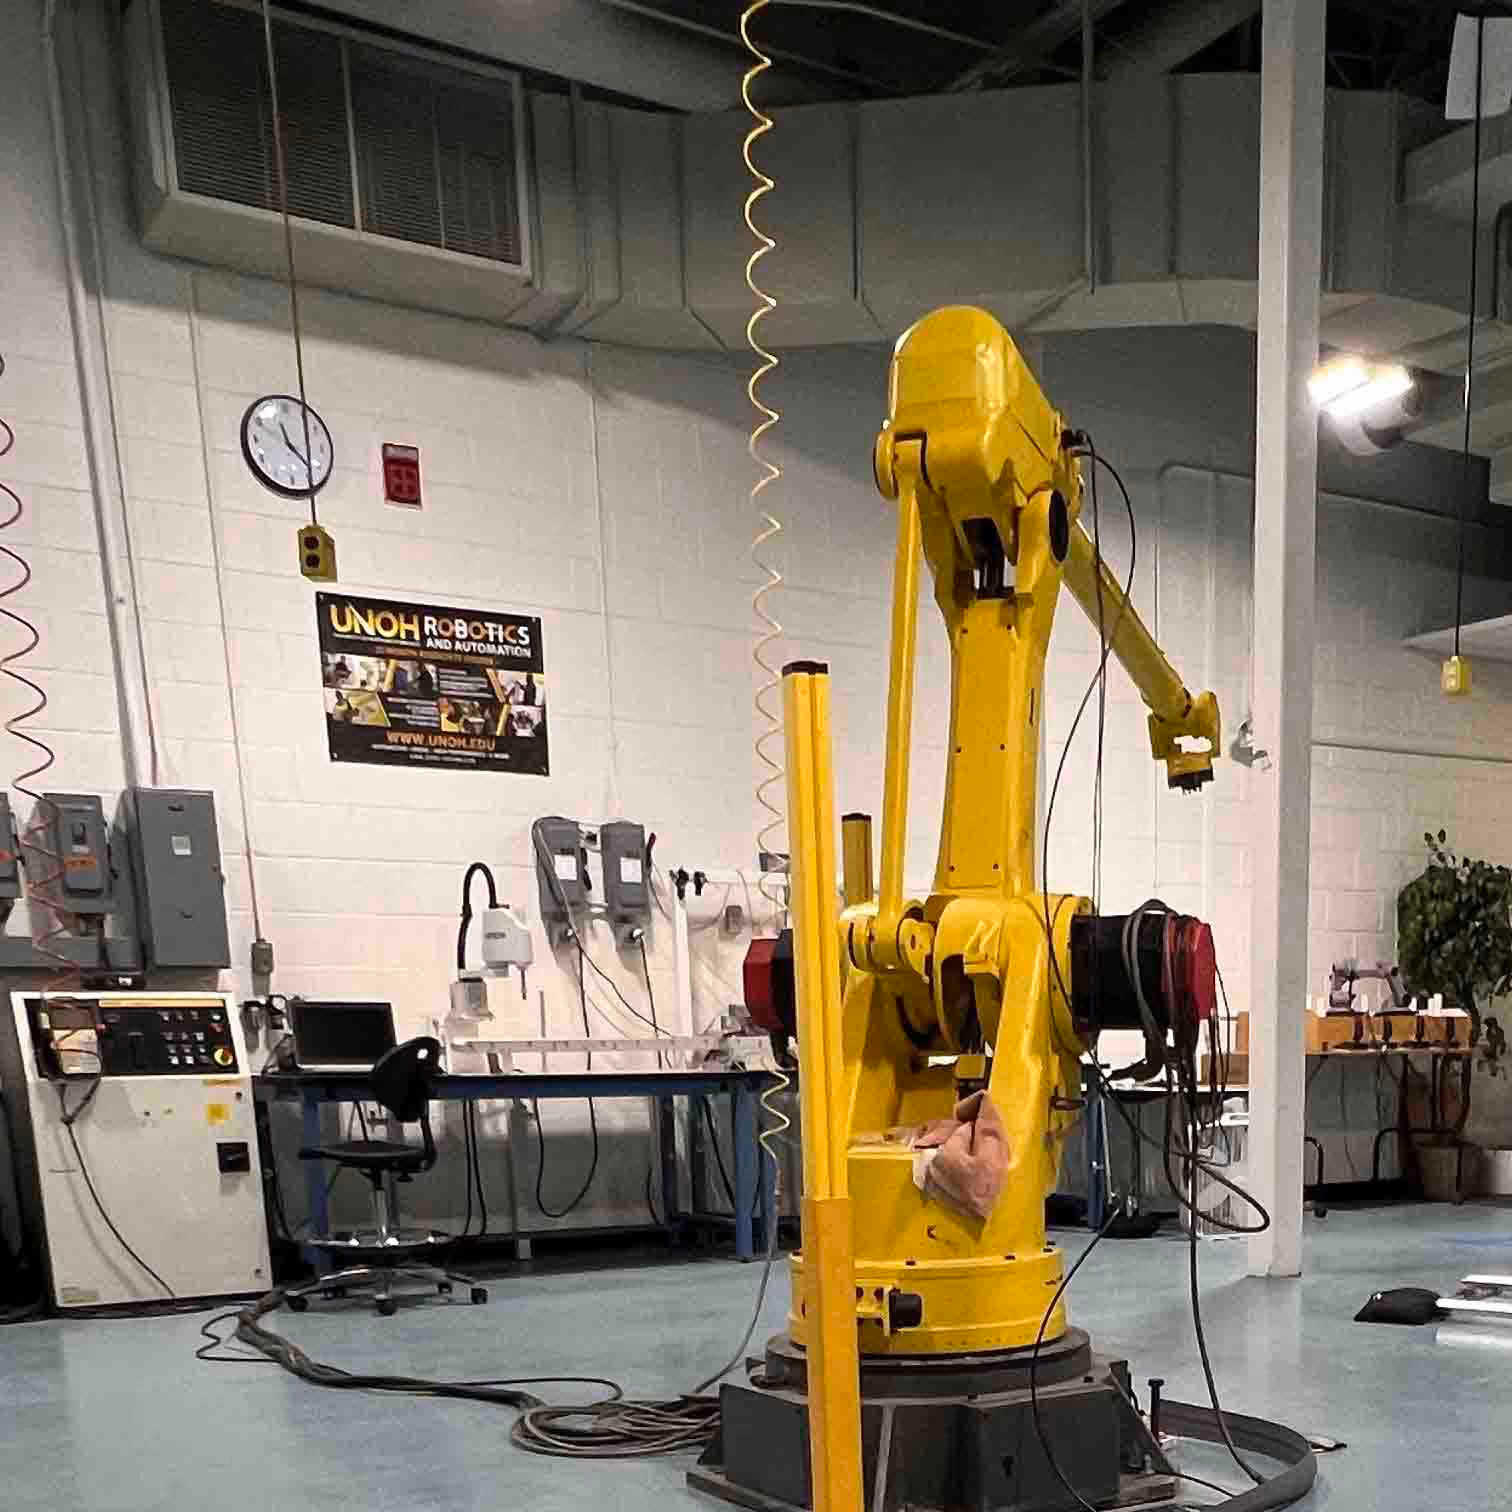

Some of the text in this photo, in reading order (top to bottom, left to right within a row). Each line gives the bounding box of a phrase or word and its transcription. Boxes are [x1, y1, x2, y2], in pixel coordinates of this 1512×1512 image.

[330, 603, 530, 646] UNOH ROBOTICS
[426, 637, 451, 650] AND
[454, 641, 532, 658] AUTOMATION
[386, 731, 496, 751] WWW.UNOH.EDU
